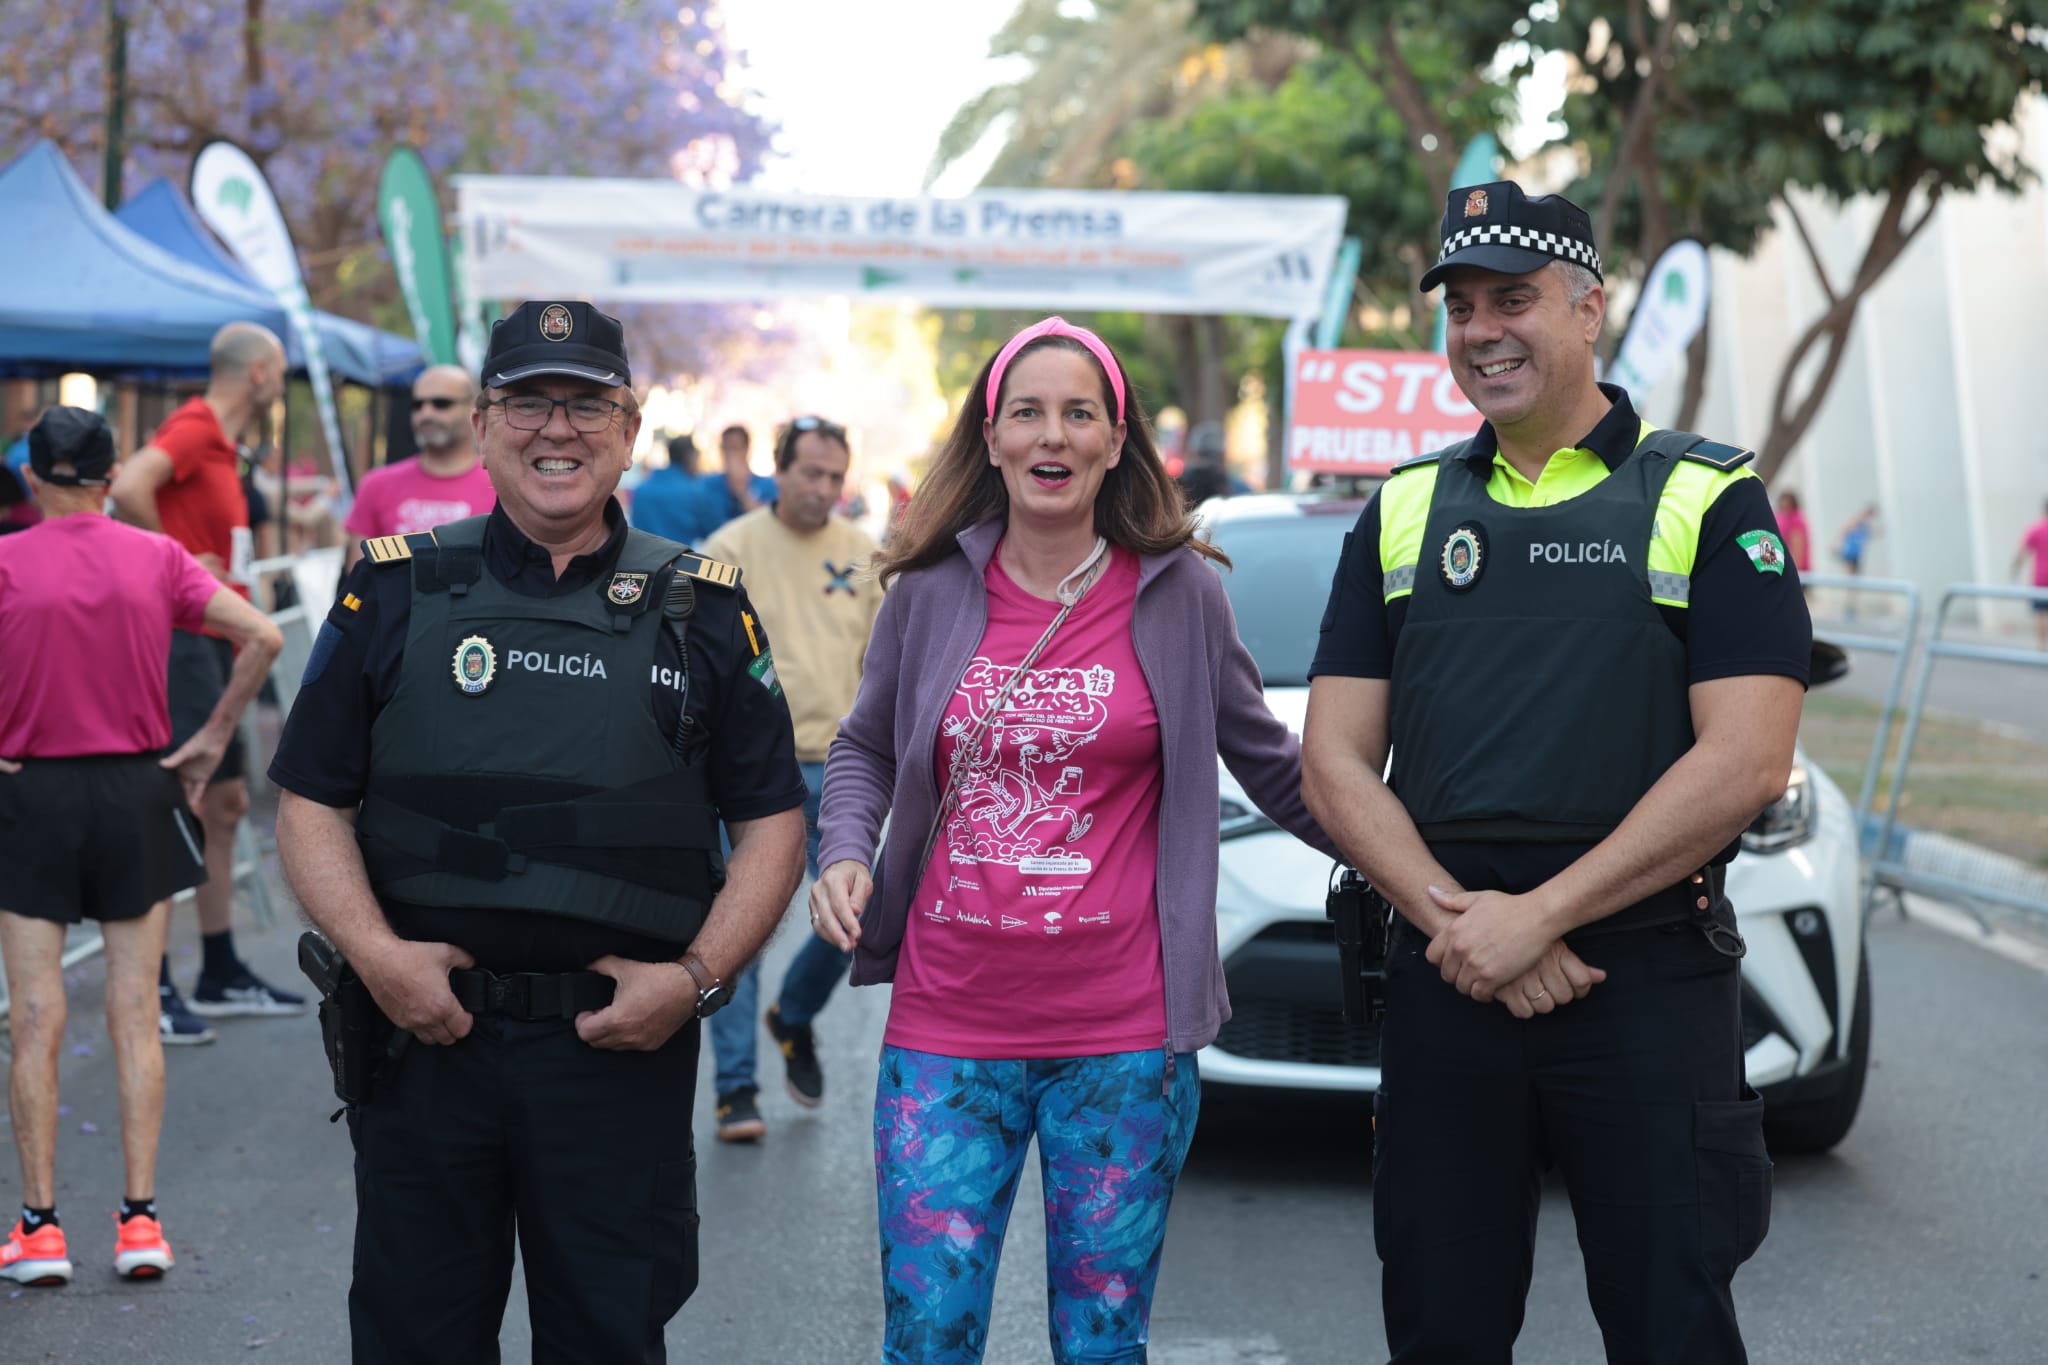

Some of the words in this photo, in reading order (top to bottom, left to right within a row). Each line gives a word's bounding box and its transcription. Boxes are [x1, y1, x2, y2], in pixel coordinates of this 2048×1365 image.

[696, 194, 851, 230] Carrera
[867, 200, 917, 231] de
[932, 201, 967, 233] la
[982, 203, 1124, 238] Prensa
[1292, 425, 1414, 462] PRUEBA
[1529, 538, 1627, 563] POLICÍA
[507, 649, 608, 679] POLICÍA
[651, 664, 686, 693] ICI
[1089, 668, 1111, 680] de
[1089, 680, 1110, 694] la
